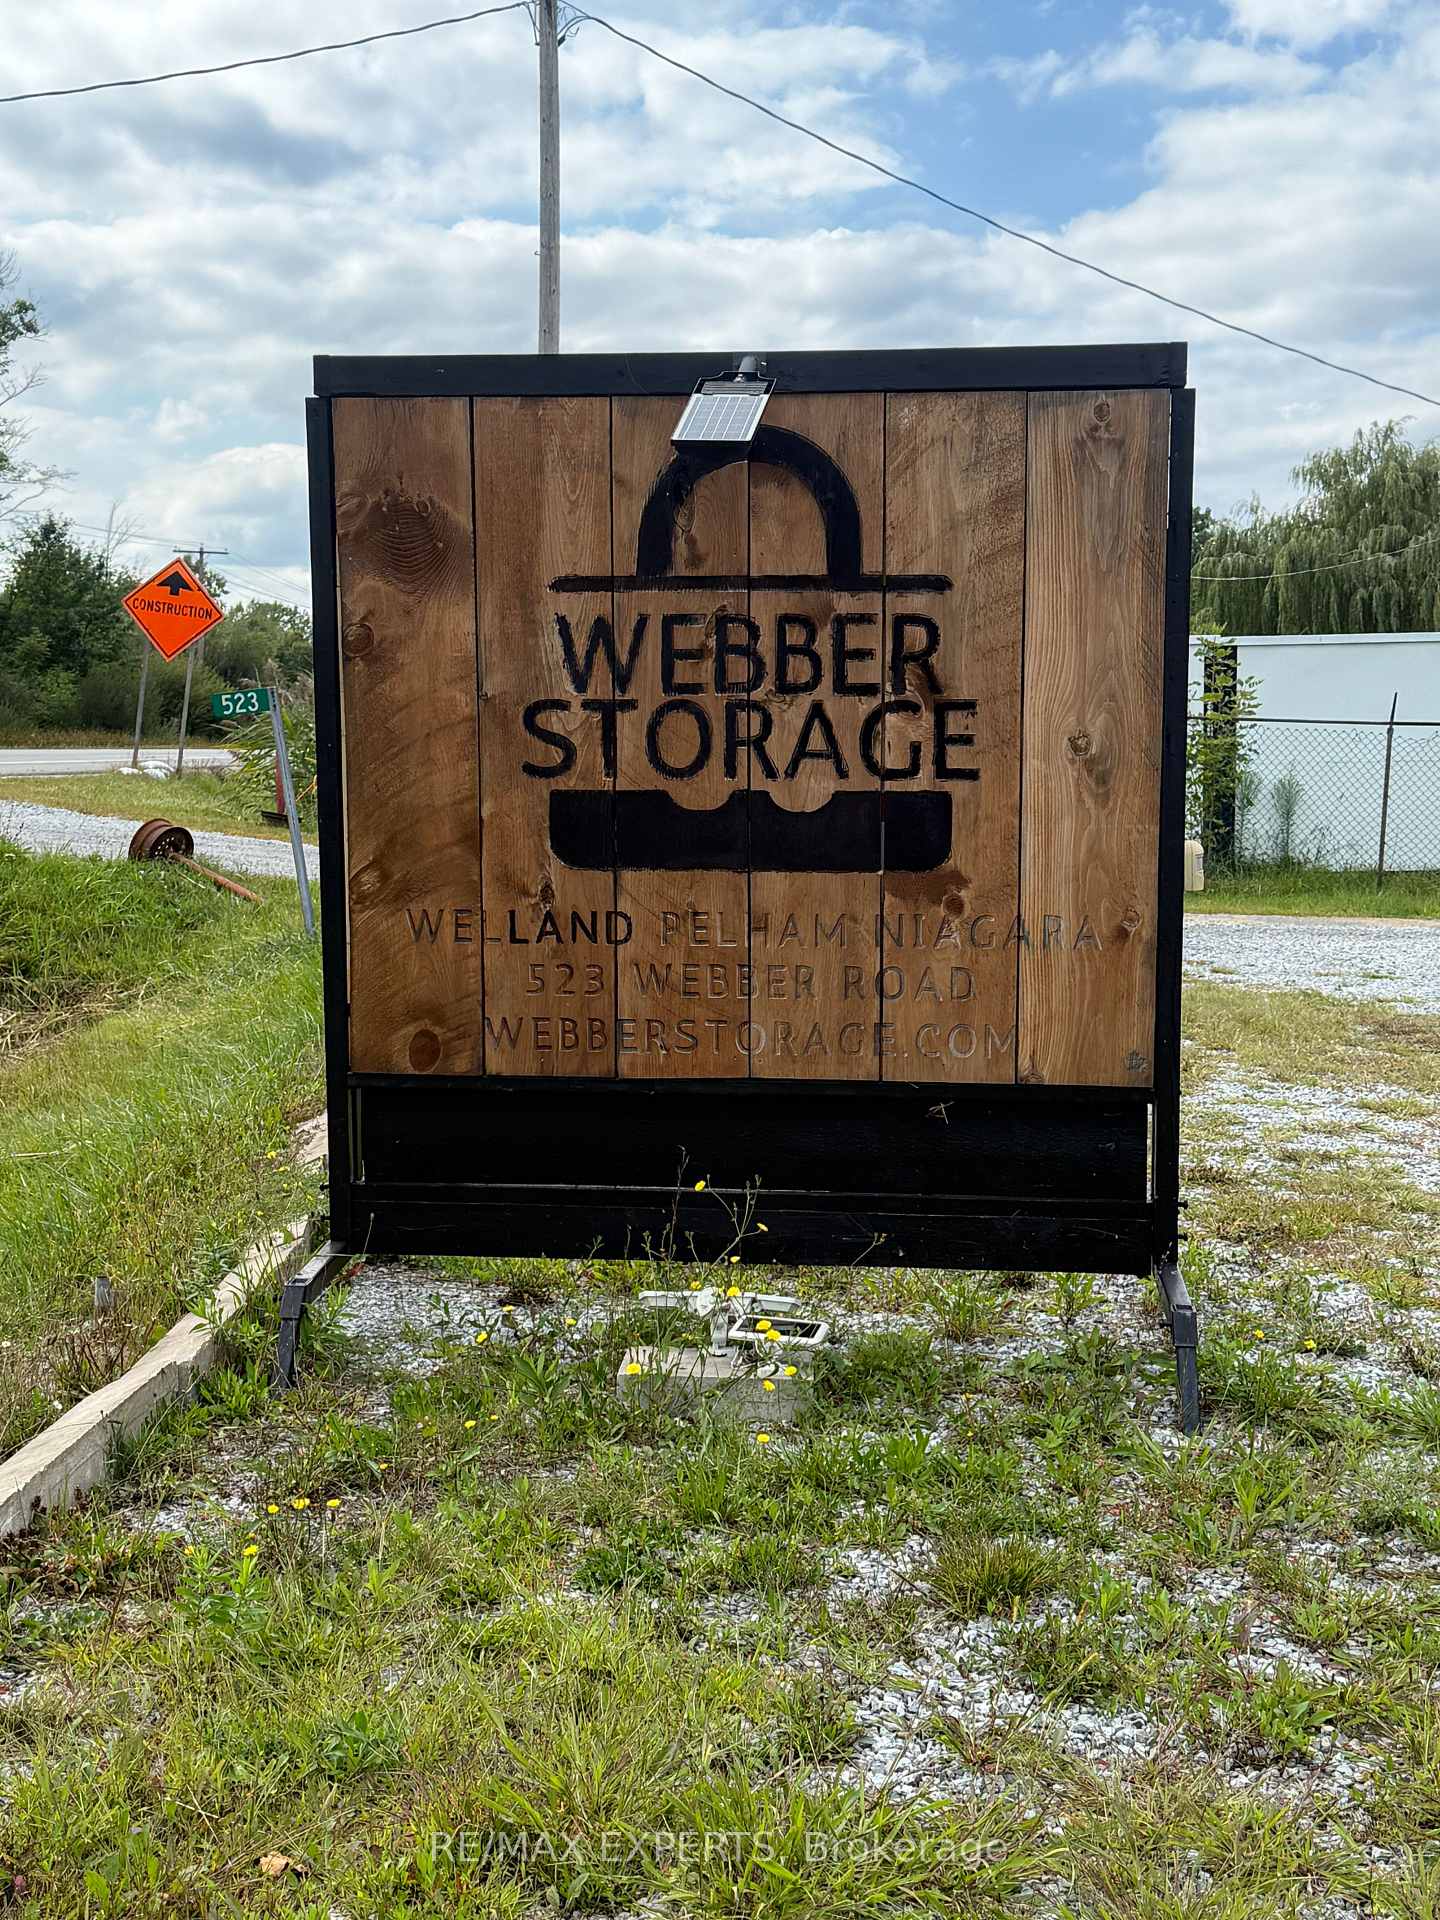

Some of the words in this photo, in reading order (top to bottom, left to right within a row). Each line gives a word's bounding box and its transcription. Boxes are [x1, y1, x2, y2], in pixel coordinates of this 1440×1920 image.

[132, 597, 213, 620] CONSTRUCTION
[554, 612, 943, 696] WEBBER
[221, 692, 259, 715] 523
[520, 699, 981, 781] STORAGE
[406, 909, 633, 945] WELLAND
[660, 911, 848, 950] PELHAM
[874, 913, 1103, 950] NIAGARA
[526, 963, 604, 997] 523
[633, 963, 815, 1000] WEBBER
[844, 965, 977, 1001] ROAD
[484, 1016, 1017, 1058] WEBBERSTORAGE.COM
